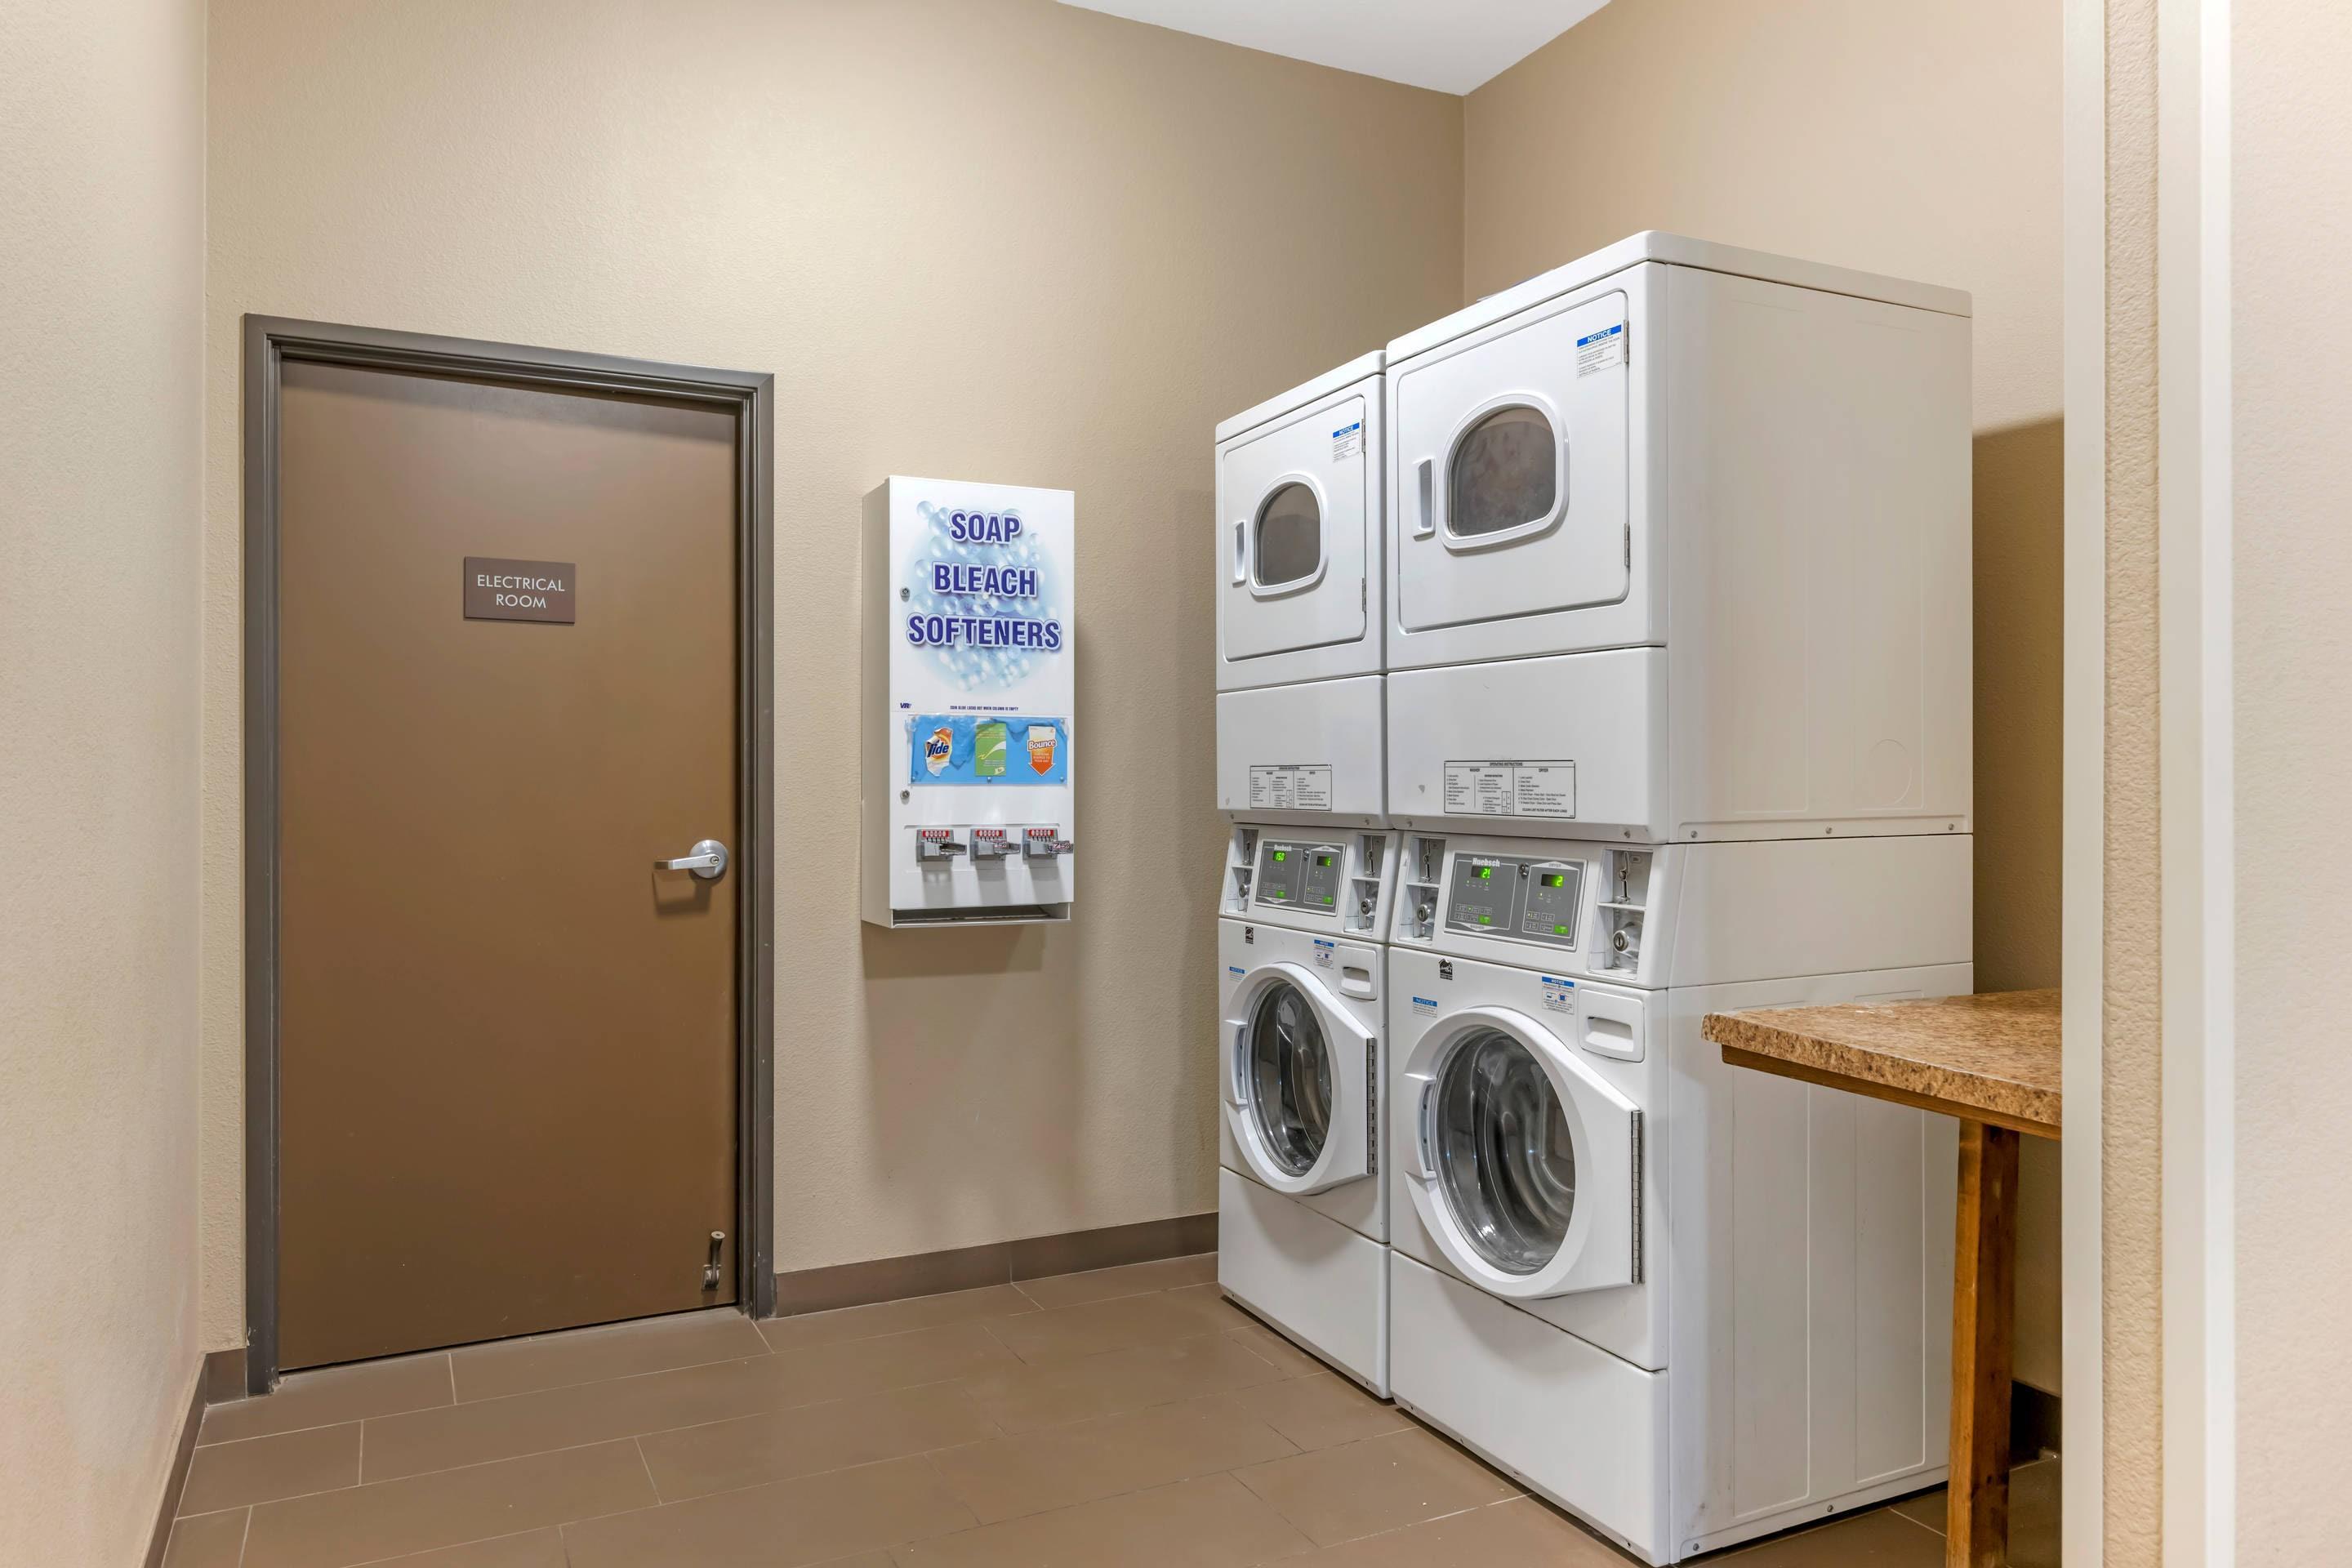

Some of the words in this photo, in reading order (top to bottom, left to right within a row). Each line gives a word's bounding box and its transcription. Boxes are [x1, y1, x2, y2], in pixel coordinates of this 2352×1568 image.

[1587, 328, 1612, 343] NOTICE
[951, 512, 1021, 543] SOAP
[477, 574, 565, 592] ELECTRICAL
[933, 564, 1036, 596] BLEACH
[496, 594, 546, 608] ROOM
[908, 615, 1060, 648] SOFTENERS
[927, 738, 950, 758] Tide
[1028, 739, 1055, 750] Bounce
